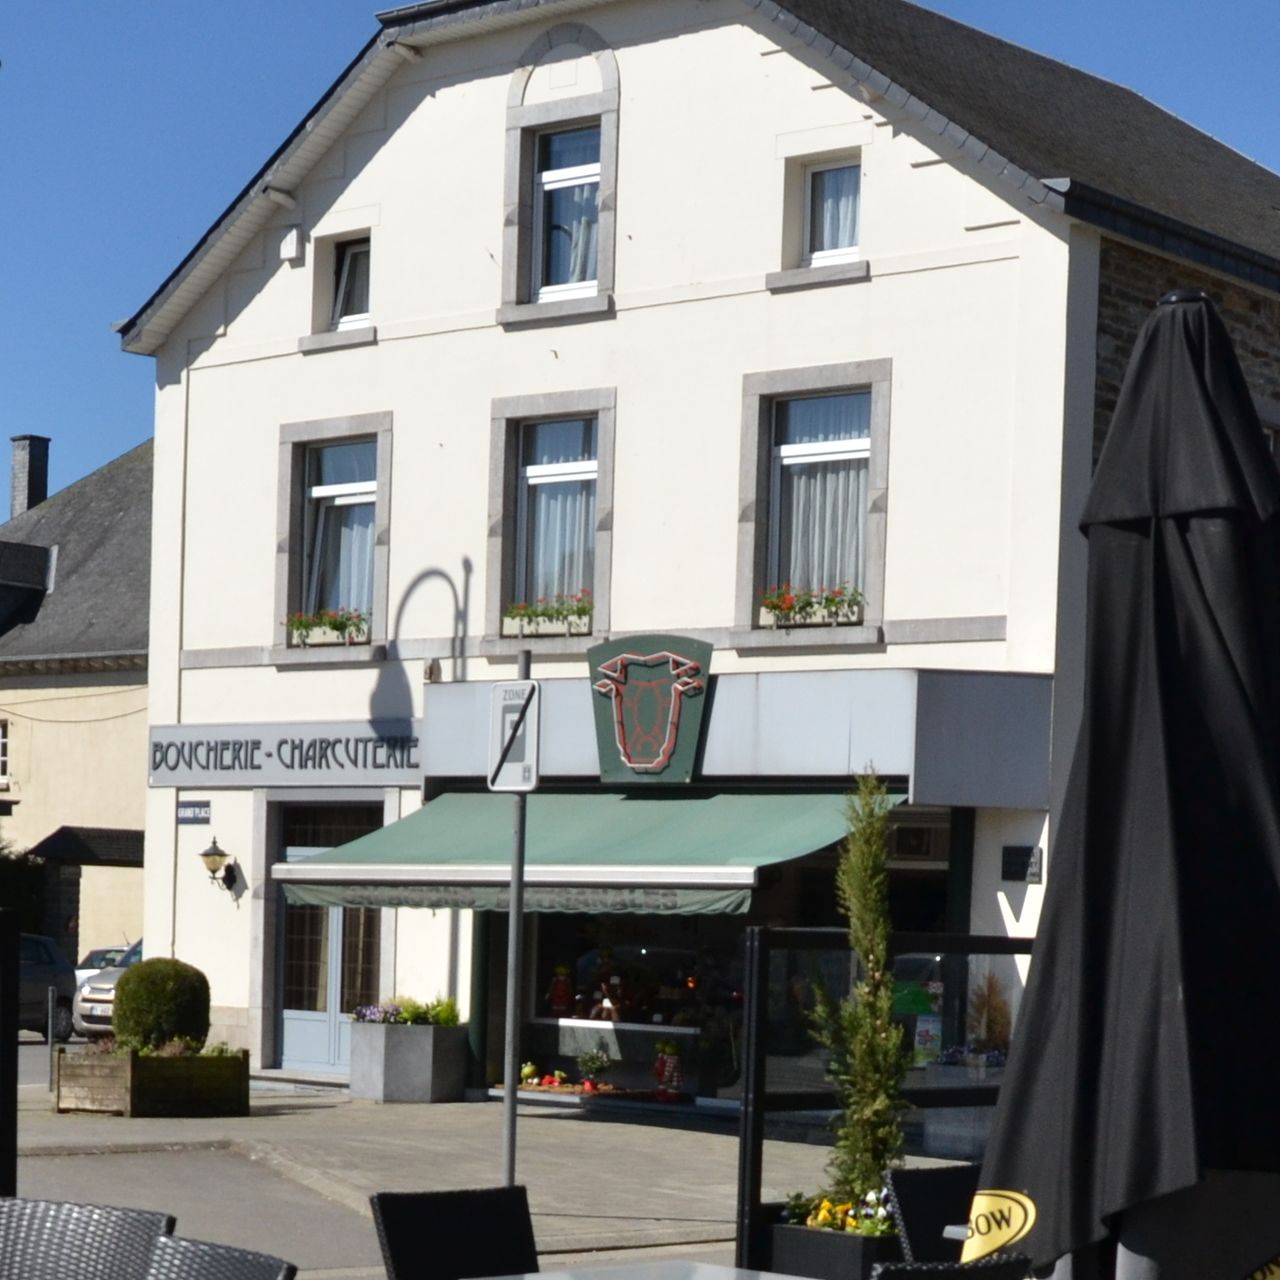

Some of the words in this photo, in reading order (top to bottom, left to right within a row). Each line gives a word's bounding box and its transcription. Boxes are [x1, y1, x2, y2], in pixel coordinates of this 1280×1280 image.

[503, 688, 526, 701] ZONE
[151, 739, 262, 771] BOUCHERIE
[277, 735, 420, 770] CHARCUTERIE
